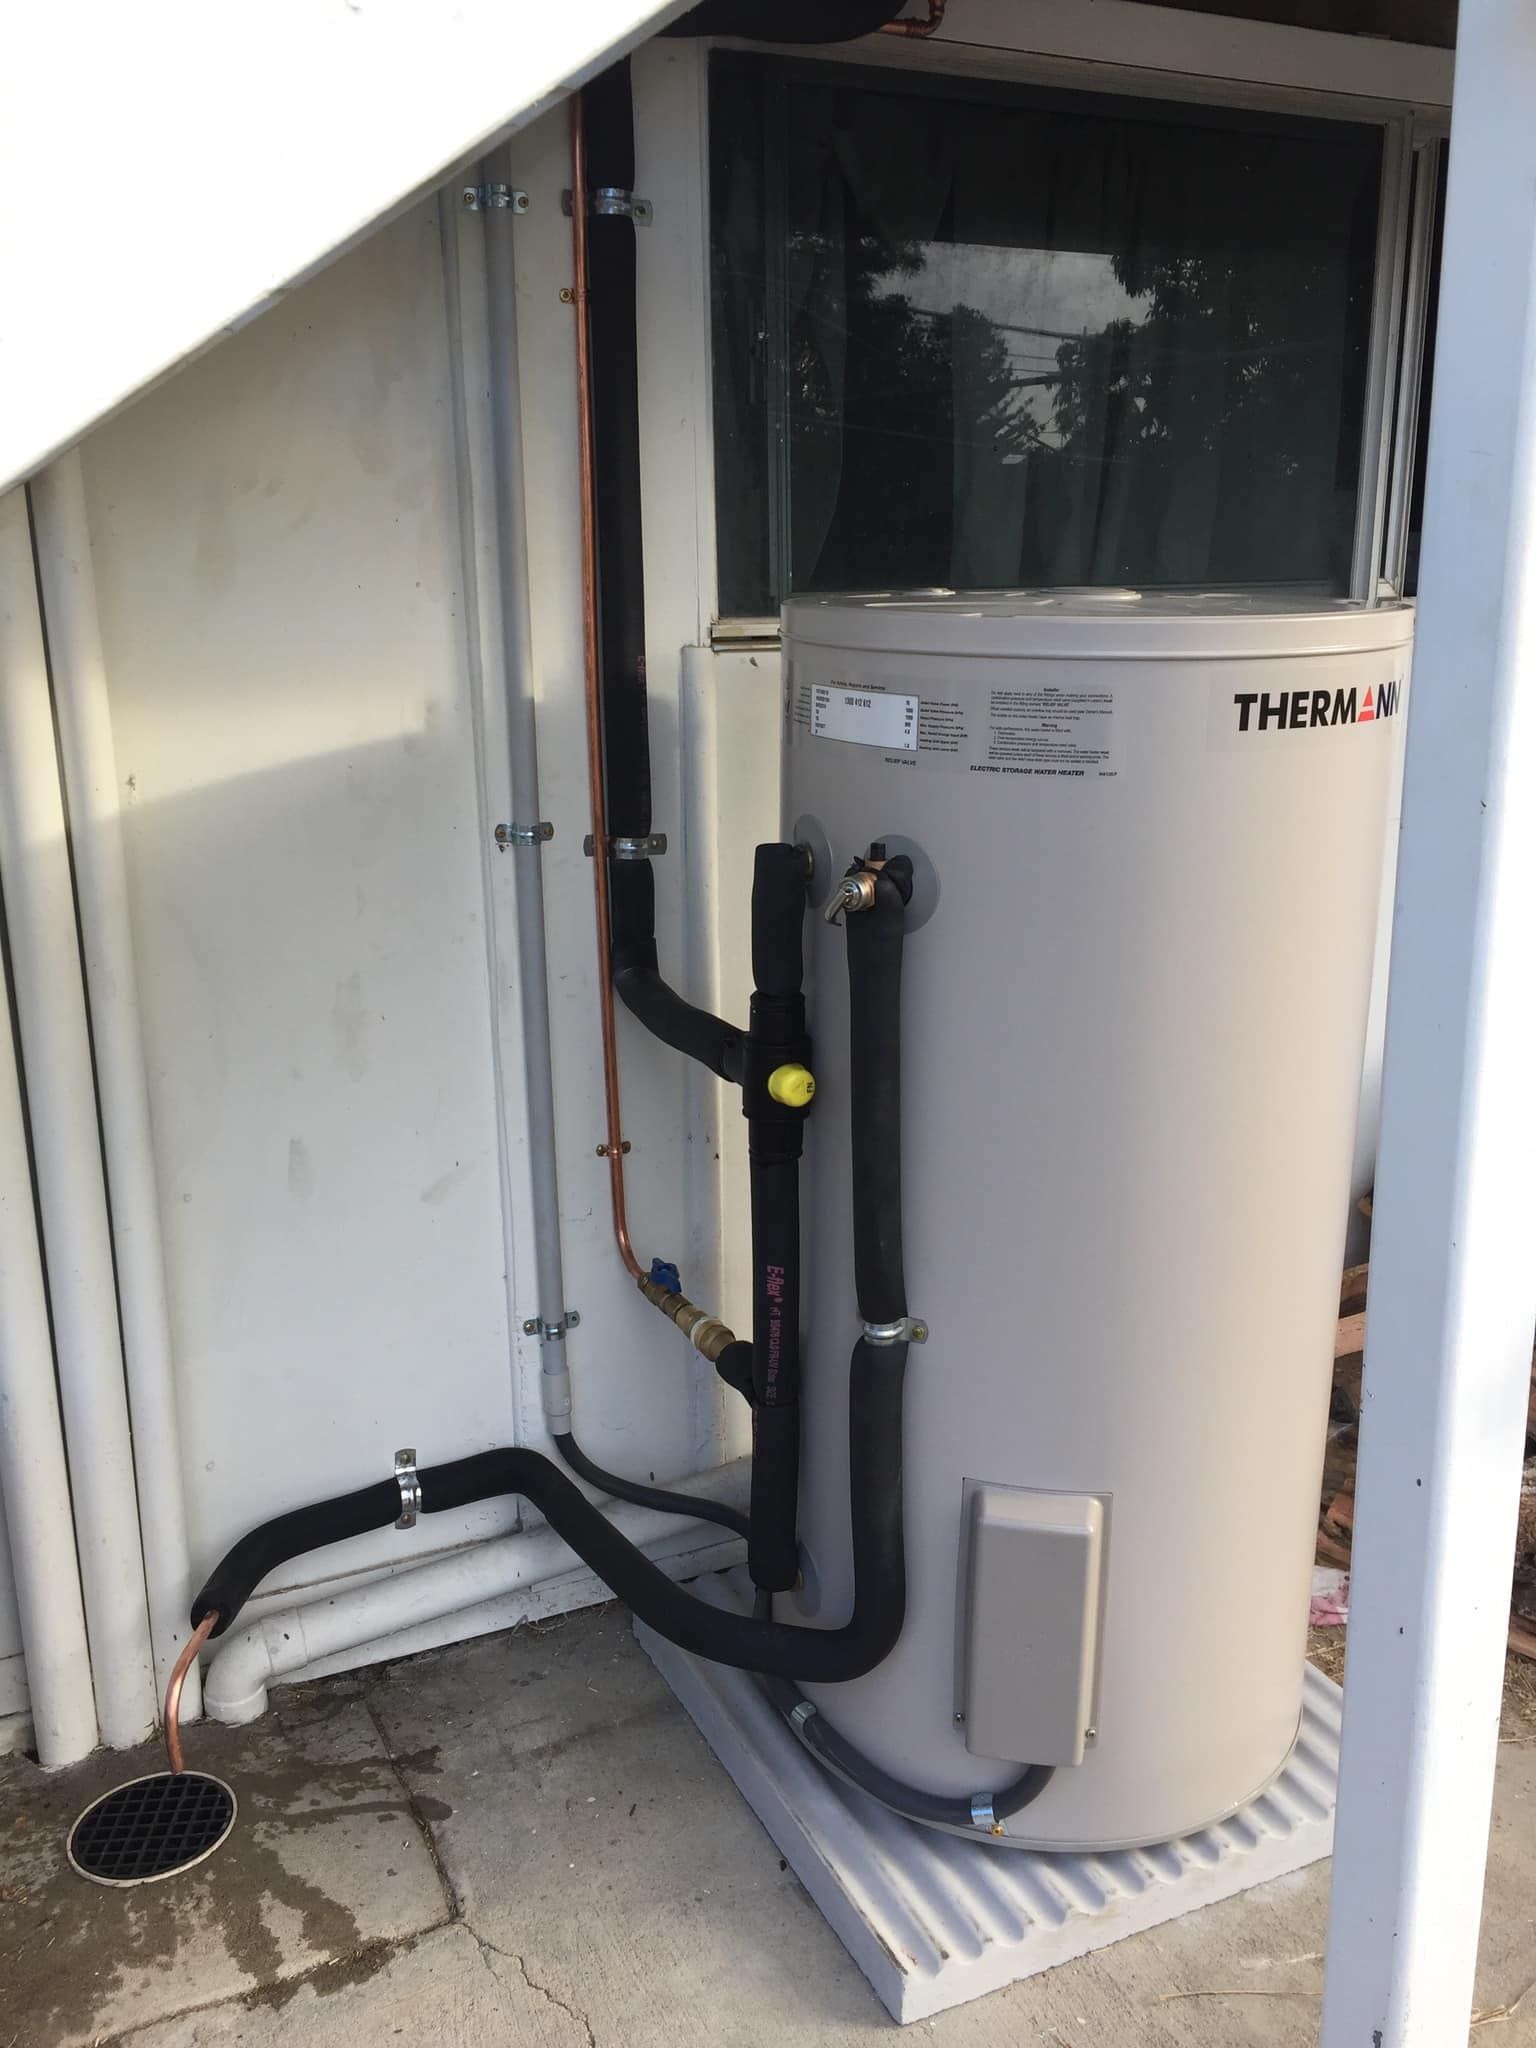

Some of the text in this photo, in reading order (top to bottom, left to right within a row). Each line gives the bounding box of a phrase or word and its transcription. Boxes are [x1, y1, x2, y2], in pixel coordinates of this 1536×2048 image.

[1234, 680, 1402, 732] THERMANN
[970, 765, 1000, 773] ELECTRIC
[1002, 767, 1034, 775] STORAGE
